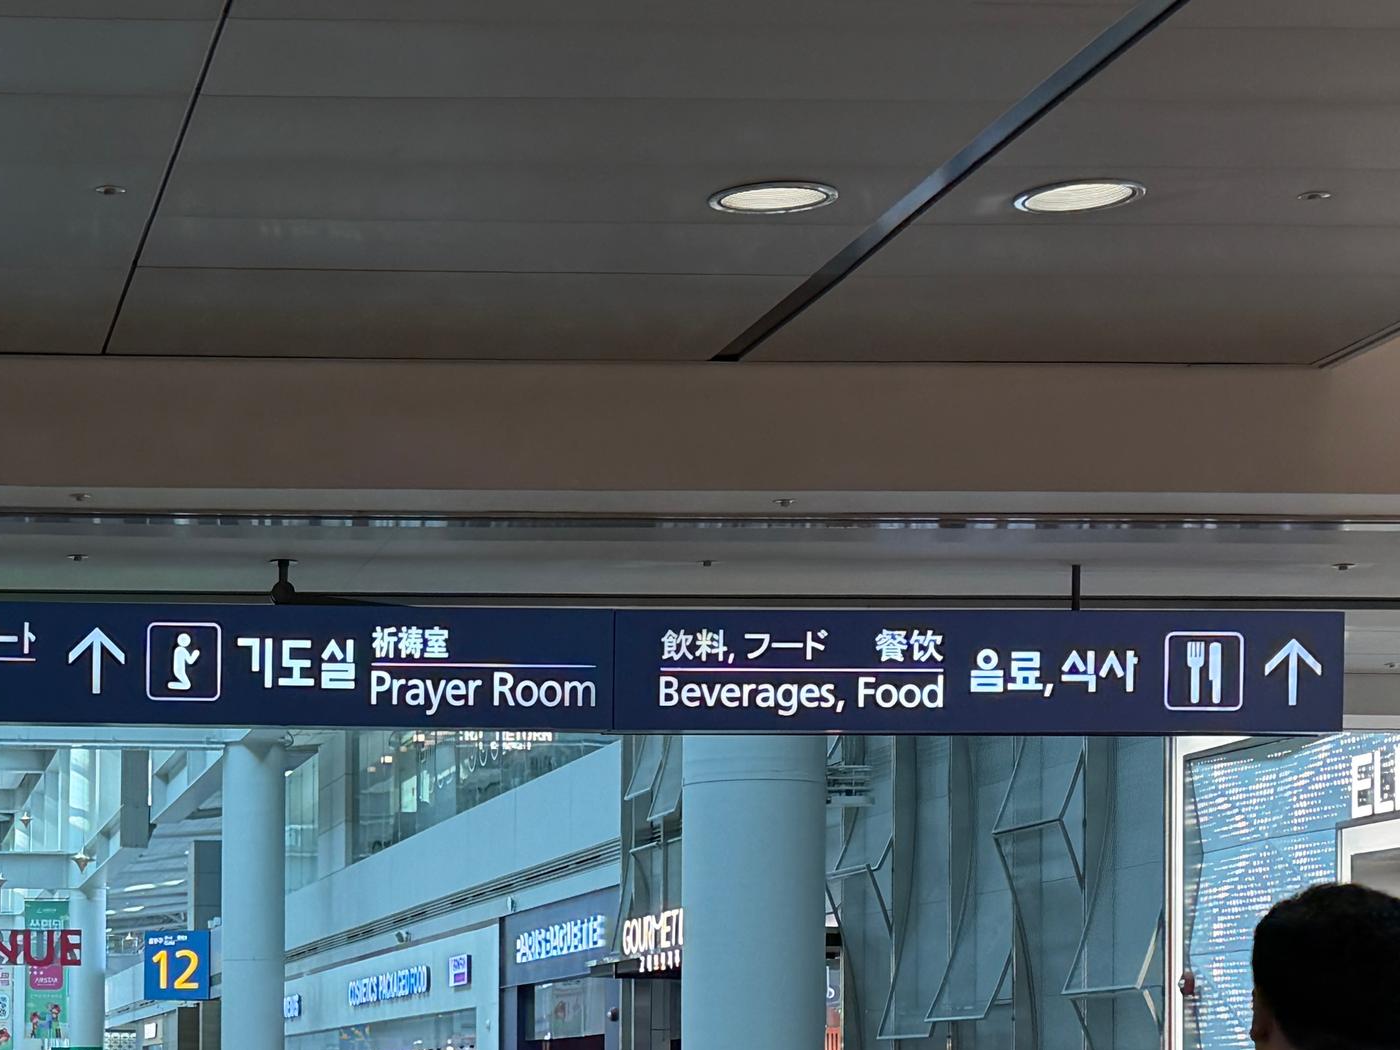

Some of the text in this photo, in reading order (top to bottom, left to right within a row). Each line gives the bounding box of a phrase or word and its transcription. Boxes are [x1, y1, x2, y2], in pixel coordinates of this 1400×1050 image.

[371, 625, 449, 659] 祈祷室
[874, 628, 944, 663] 餐饮
[237, 637, 356, 690] 기도실
[370, 670, 596, 716] Prayer Room
[659, 675, 944, 716] Beverages, Food
[1352, 748, 1400, 819] EL
[623, 910, 679, 955] GOURMET
[152, 949, 200, 989] 12
[348, 974, 378, 1006] COSMETICS
[409, 965, 428, 995] FOOD
